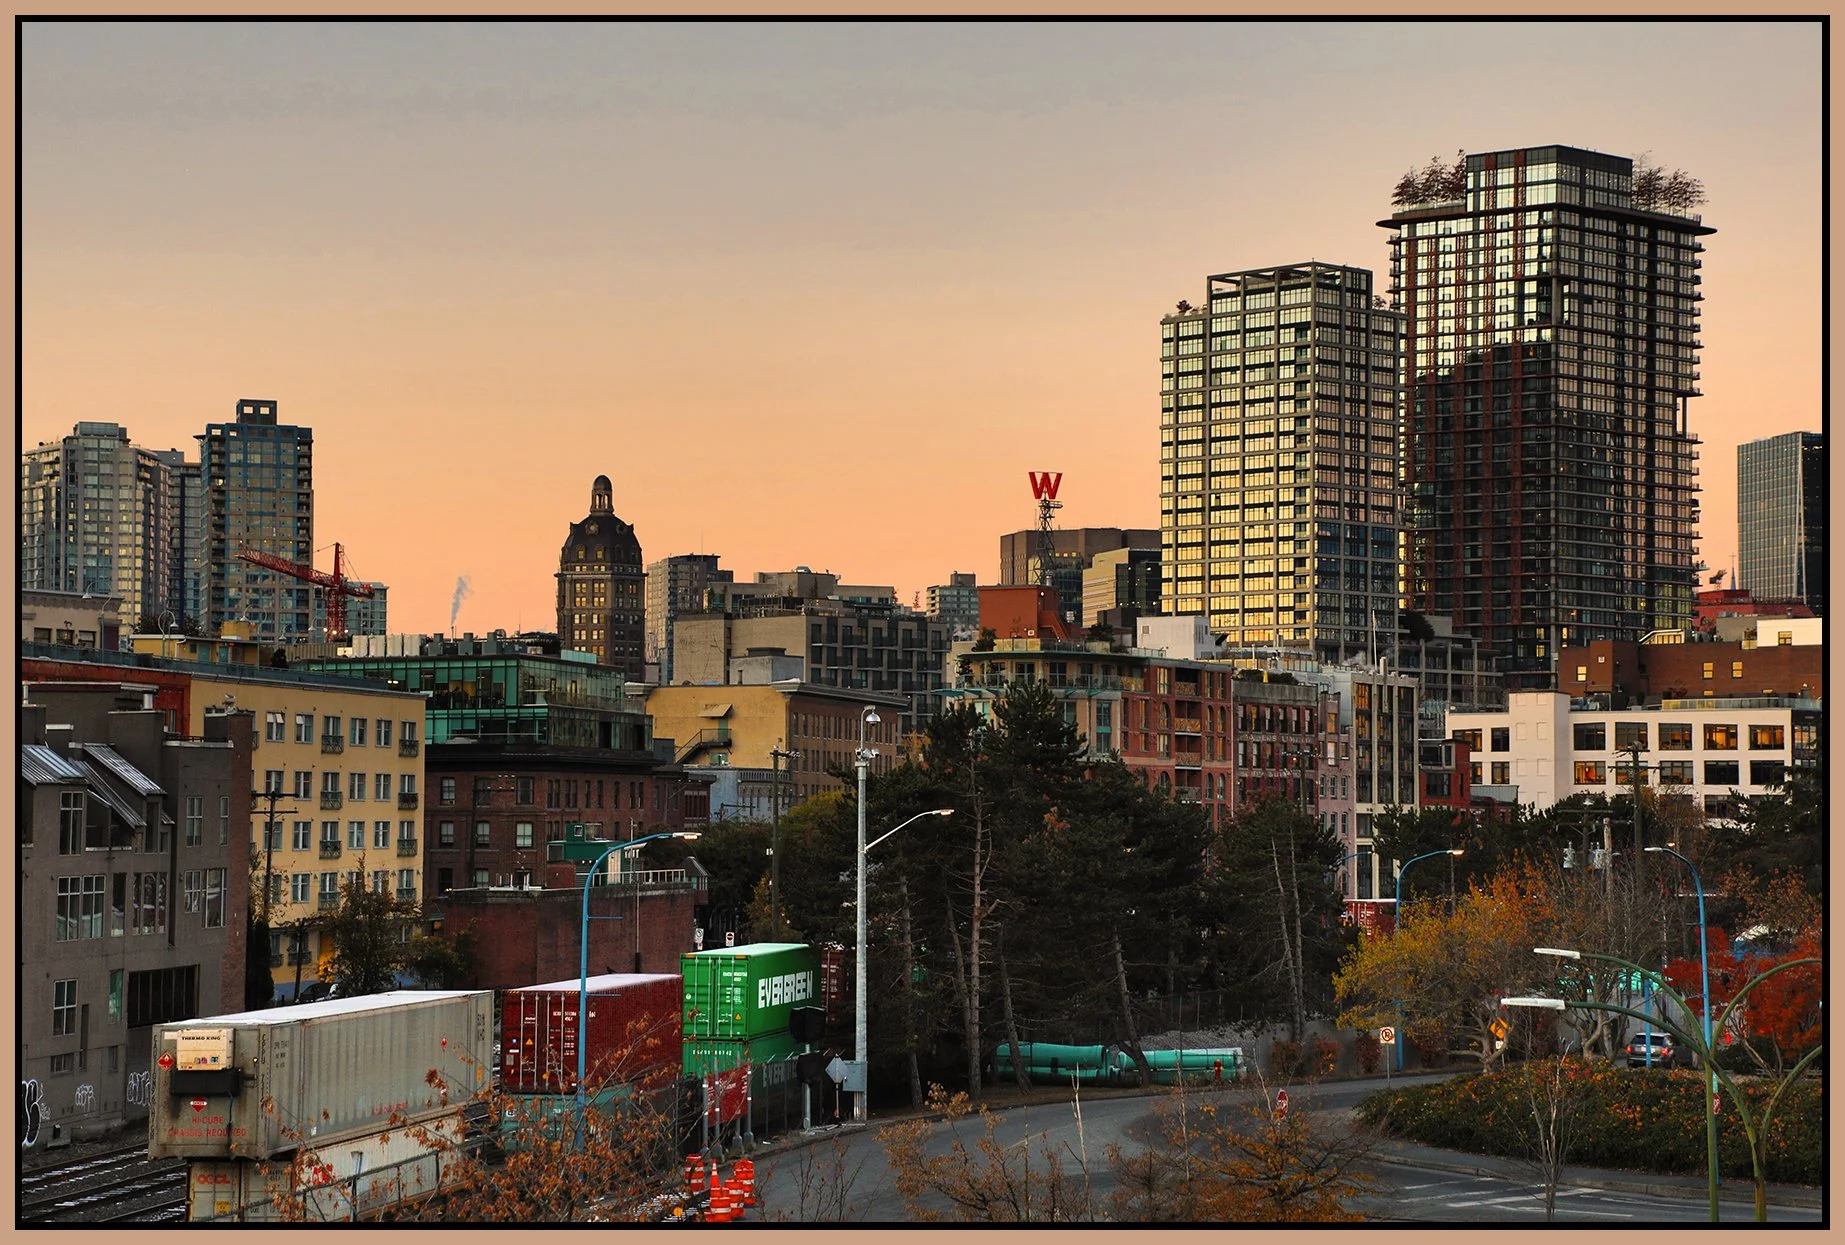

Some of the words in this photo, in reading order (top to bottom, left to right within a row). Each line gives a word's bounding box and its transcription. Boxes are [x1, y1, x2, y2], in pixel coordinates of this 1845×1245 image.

[1028, 471, 1063, 500] W
[758, 970, 813, 1009] EVERGREEN
[191, 1116, 224, 1125] HI-CUBE
[167, 1128, 203, 1137] CHASSIS
[206, 1128, 247, 1137] REQURED
